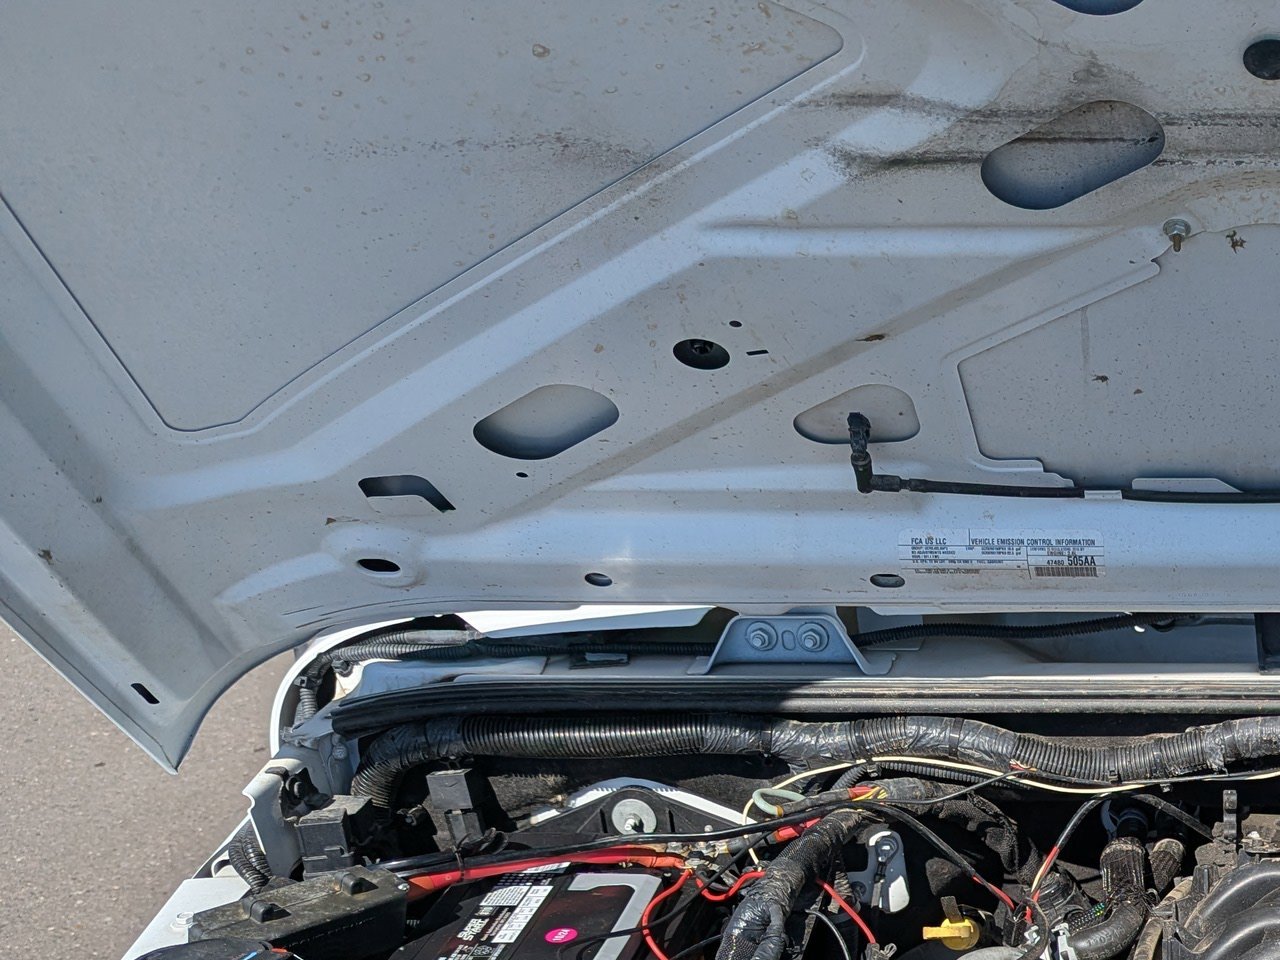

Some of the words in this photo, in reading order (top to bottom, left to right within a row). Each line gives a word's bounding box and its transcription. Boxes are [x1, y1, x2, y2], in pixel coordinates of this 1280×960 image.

[911, 537, 923, 545] FCA
[925, 537, 934, 545] US
[935, 537, 947, 545] LLC
[971, 538, 995, 546] VEHICLE
[996, 538, 1025, 546] EMISSION
[1026, 538, 1053, 546] CONTROL
[1055, 538, 1096, 546] INFORMATION
[1067, 556, 1096, 566] 505AA
